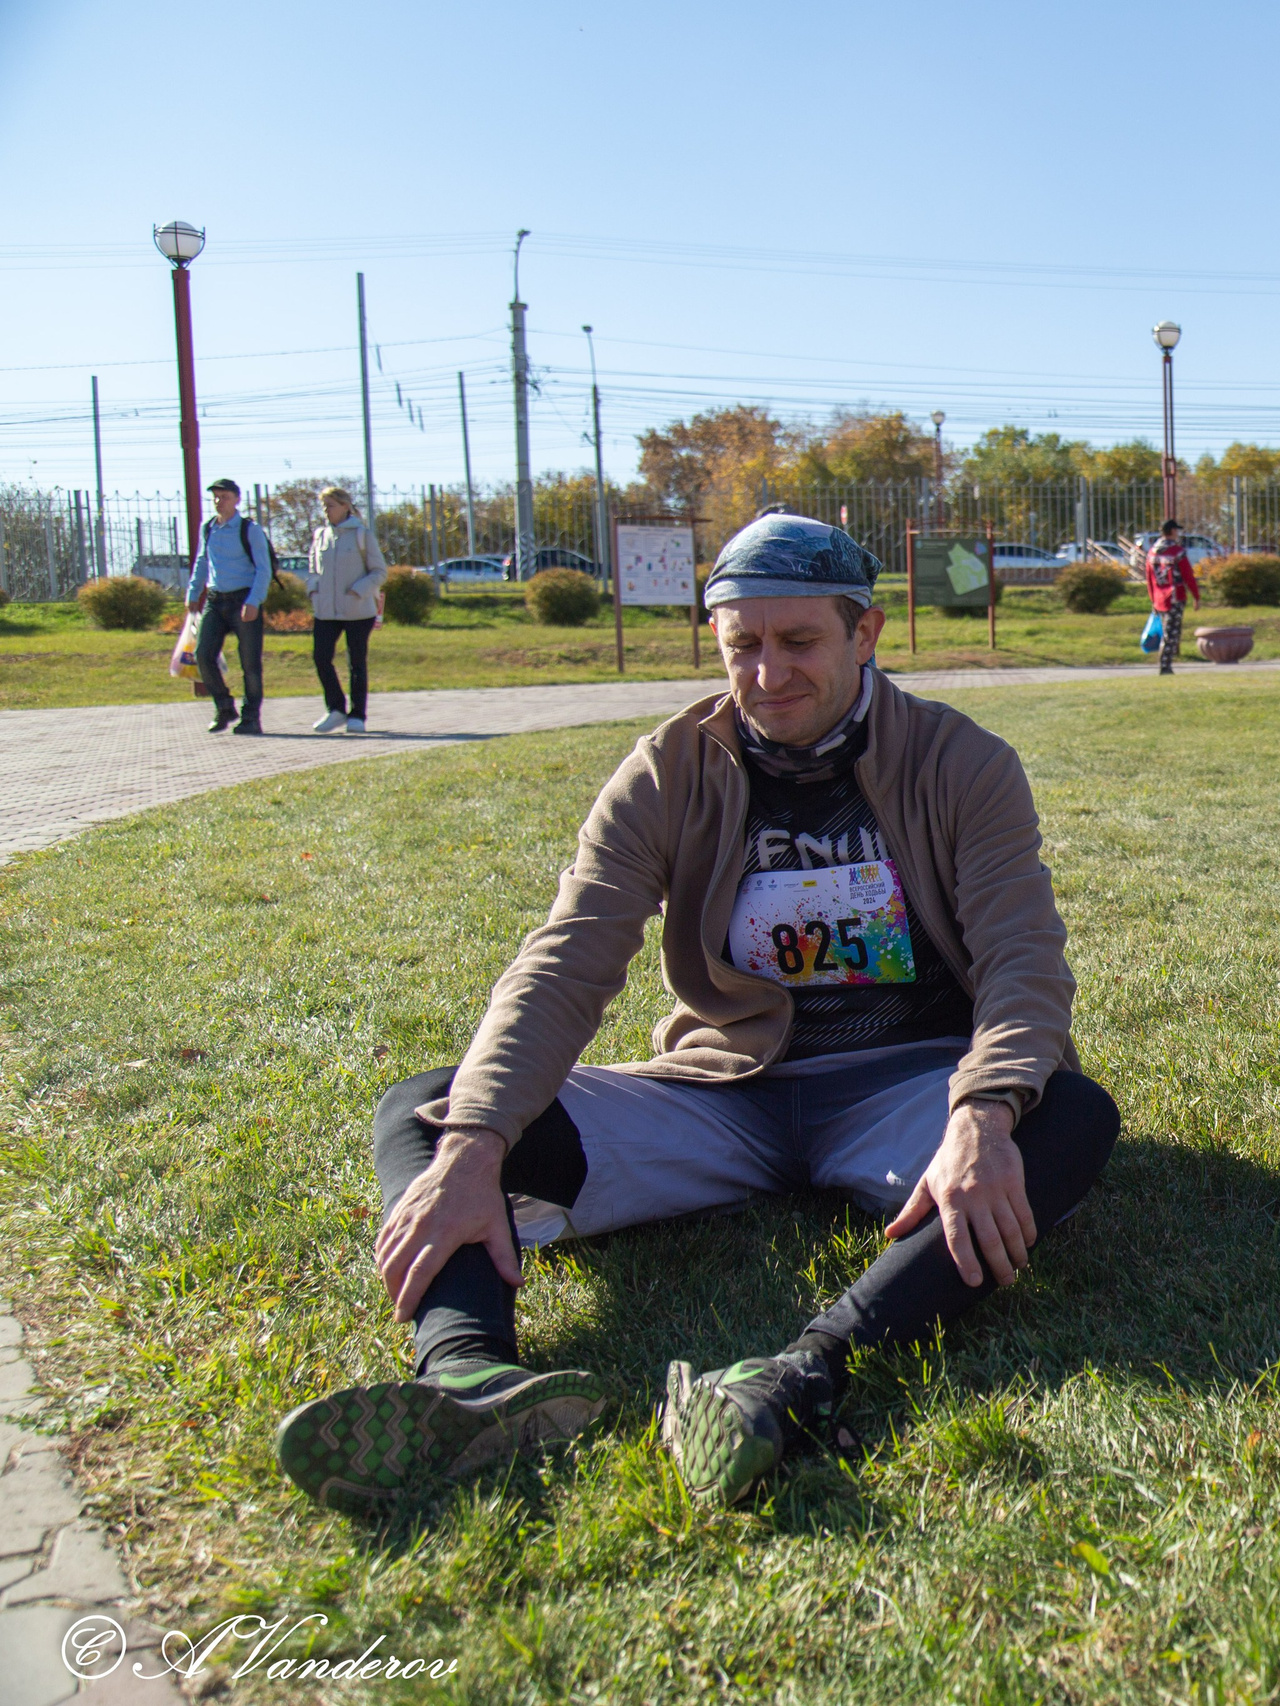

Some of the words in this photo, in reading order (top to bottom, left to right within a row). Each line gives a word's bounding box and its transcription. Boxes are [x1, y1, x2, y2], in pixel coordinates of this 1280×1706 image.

[850, 891, 864, 900] ДЕНЬ
[865, 888, 886, 897] ХОДЬБЫ
[862, 897, 876, 905] 2024
[772, 917, 869, 975] 825
